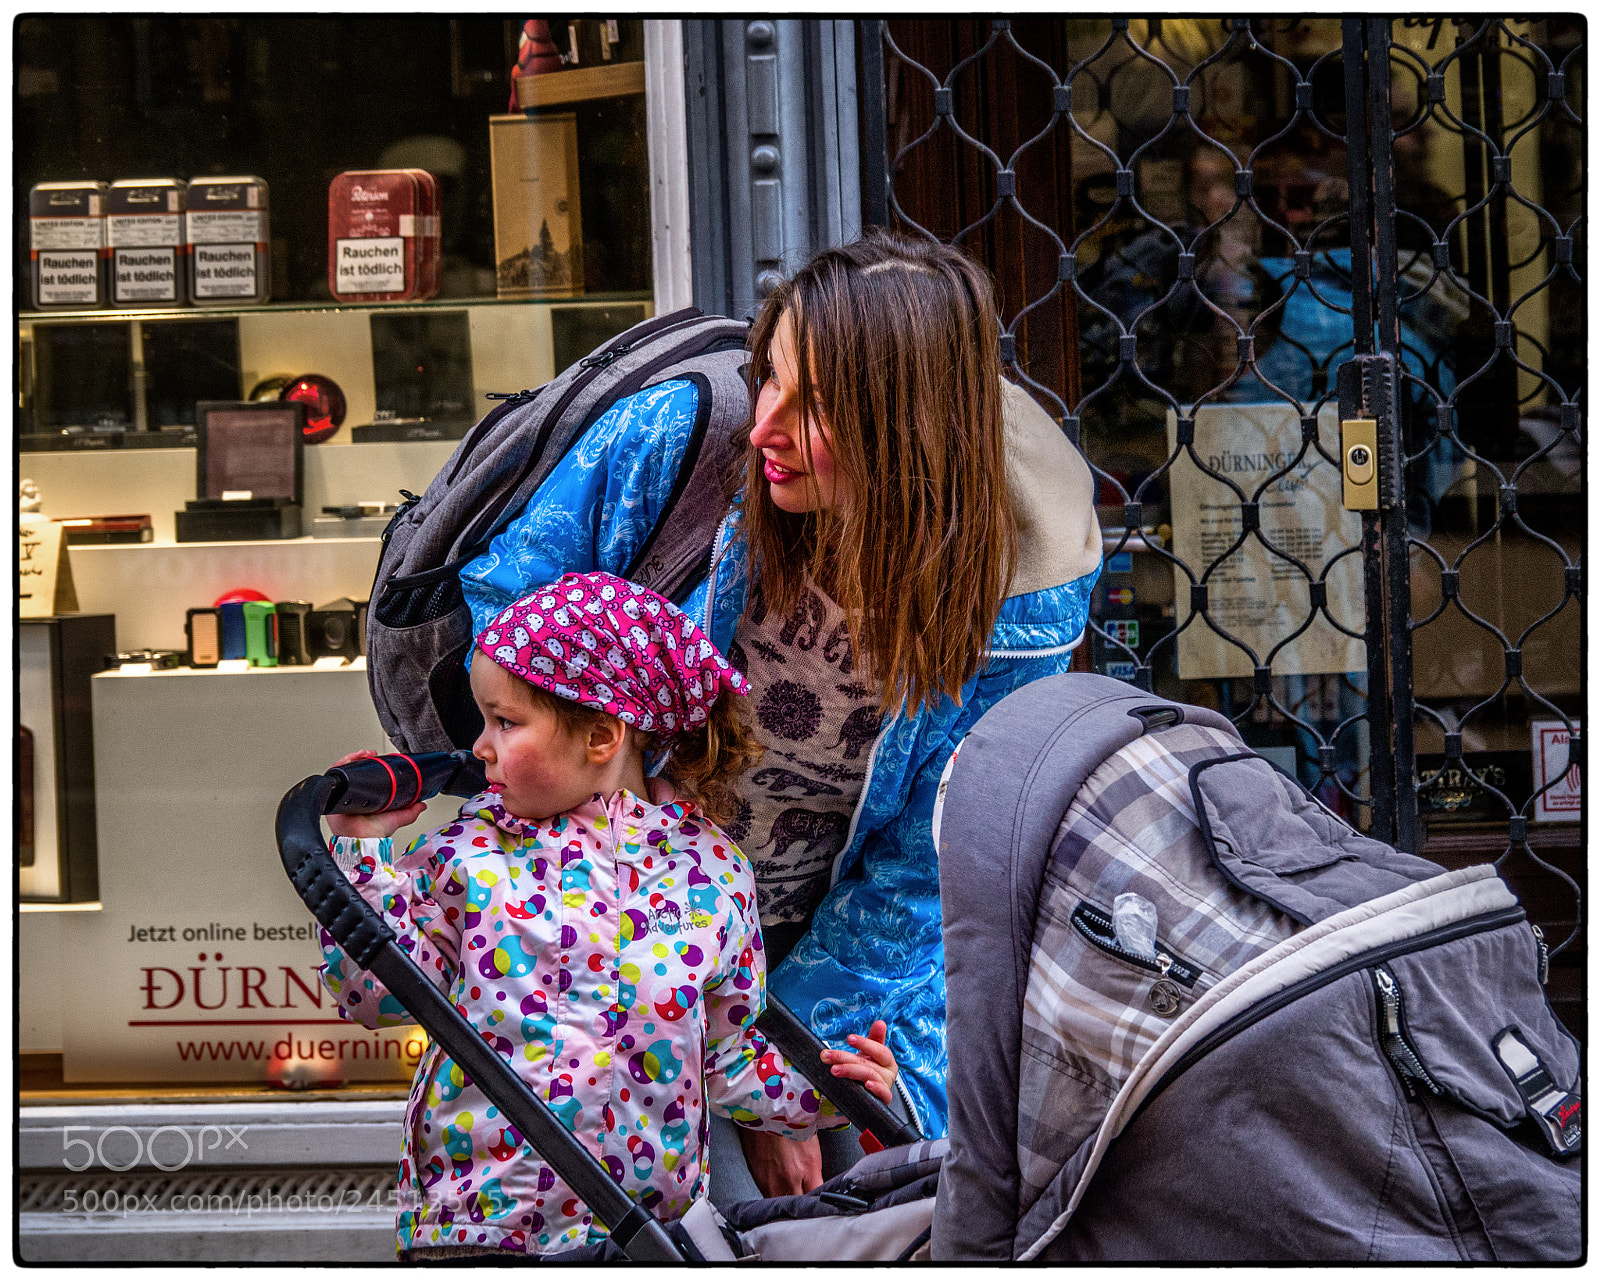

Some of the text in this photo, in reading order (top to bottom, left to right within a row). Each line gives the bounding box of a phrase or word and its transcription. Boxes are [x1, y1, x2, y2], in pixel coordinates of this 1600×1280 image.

[199, 251, 251, 262] Rauchen
[342, 246, 399, 258] Rauchen
[43, 257, 94, 269] Rauchen
[119, 254, 171, 266] Rauchen
[117, 270, 175, 282] ist tödlich
[196, 266, 256, 279] ist tödlich
[340, 263, 402, 276] ist tödlich
[40, 273, 97, 286] ist tödlich
[1551, 734, 1570, 745] Ala
[648, 907, 682, 922] Arctic
[128, 922, 319, 943] Jetzt online bestell
[644, 919, 709, 935] Adventures
[176, 1033, 425, 1067] www.duerning
